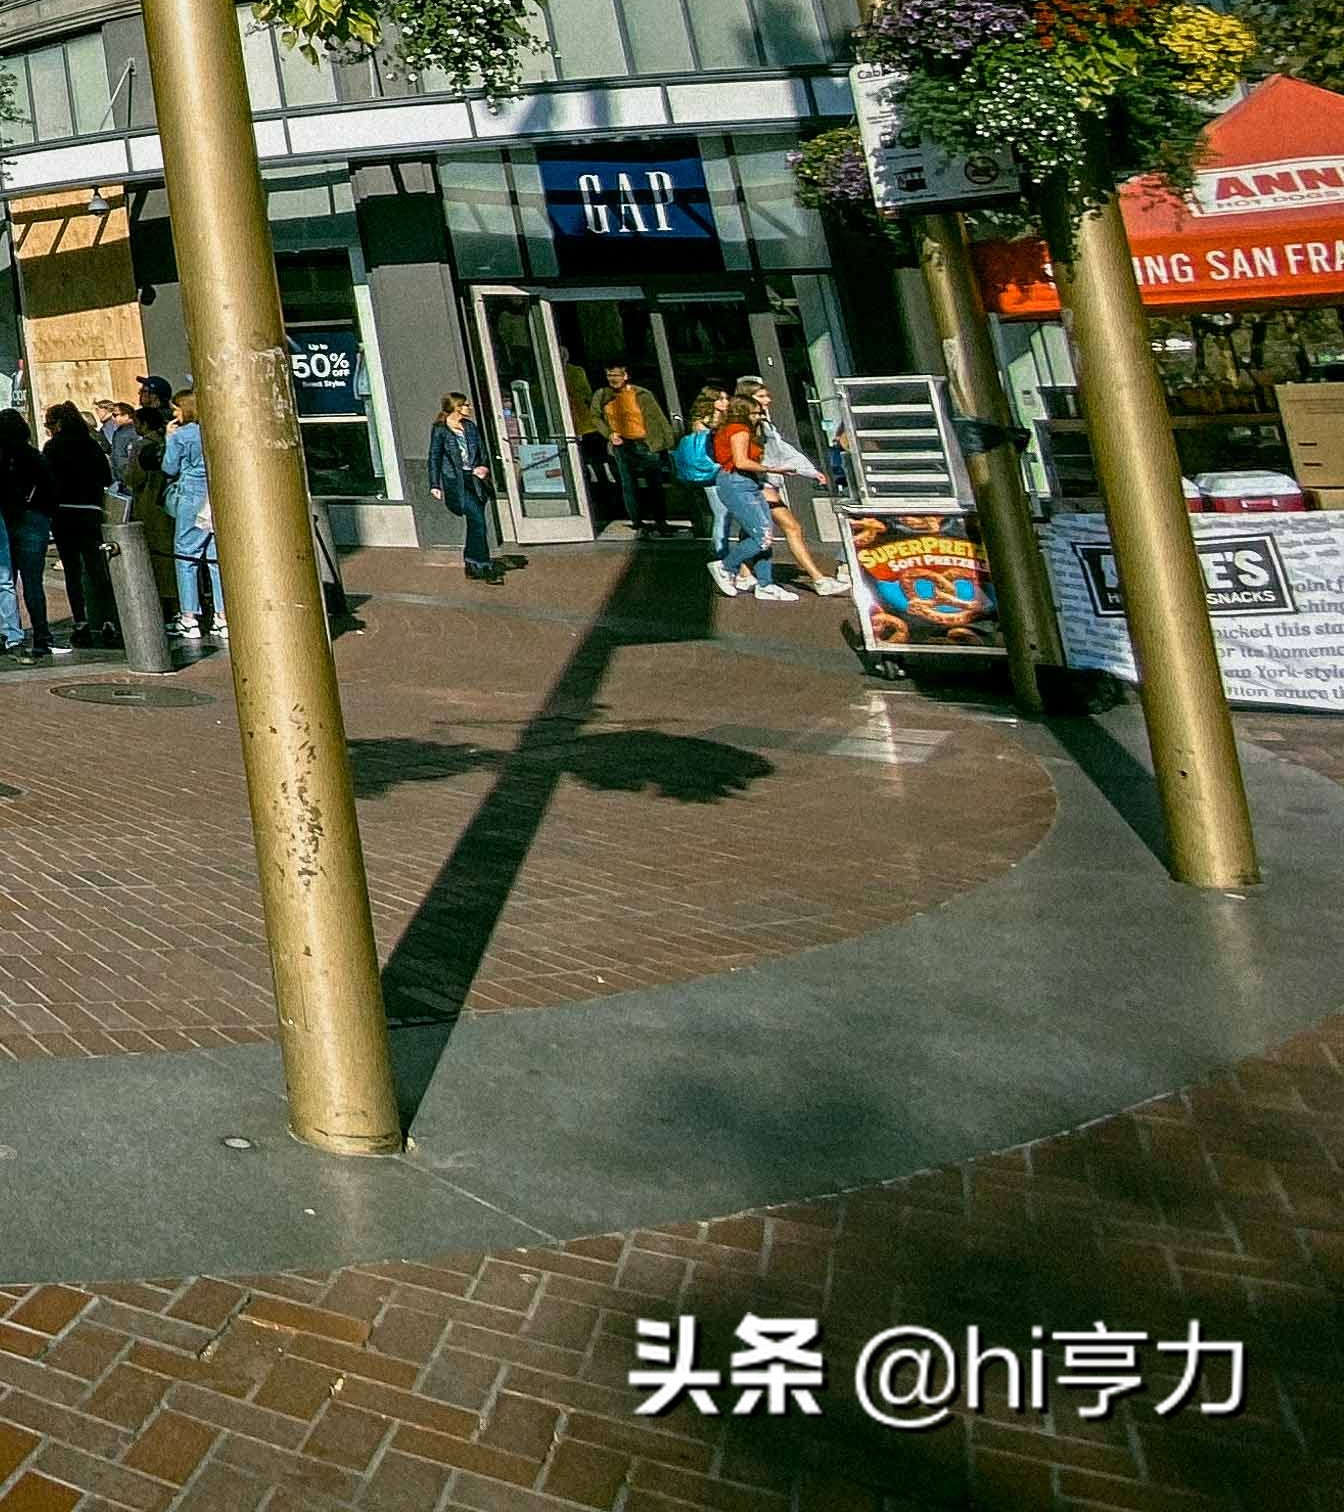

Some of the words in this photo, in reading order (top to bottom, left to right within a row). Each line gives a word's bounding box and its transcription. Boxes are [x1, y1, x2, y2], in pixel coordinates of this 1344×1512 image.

[578, 171, 675, 234] GAP
[1216, 195, 1264, 209] HOT
[1271, 191, 1336, 204] DOGS
[1205, 246, 1279, 281] SAN
[291, 352, 350, 378] 50%
[888, 555, 924, 573] SOFT
[1206, 590, 1276, 605] SNACKS
[1275, 622, 1311, 637] this
